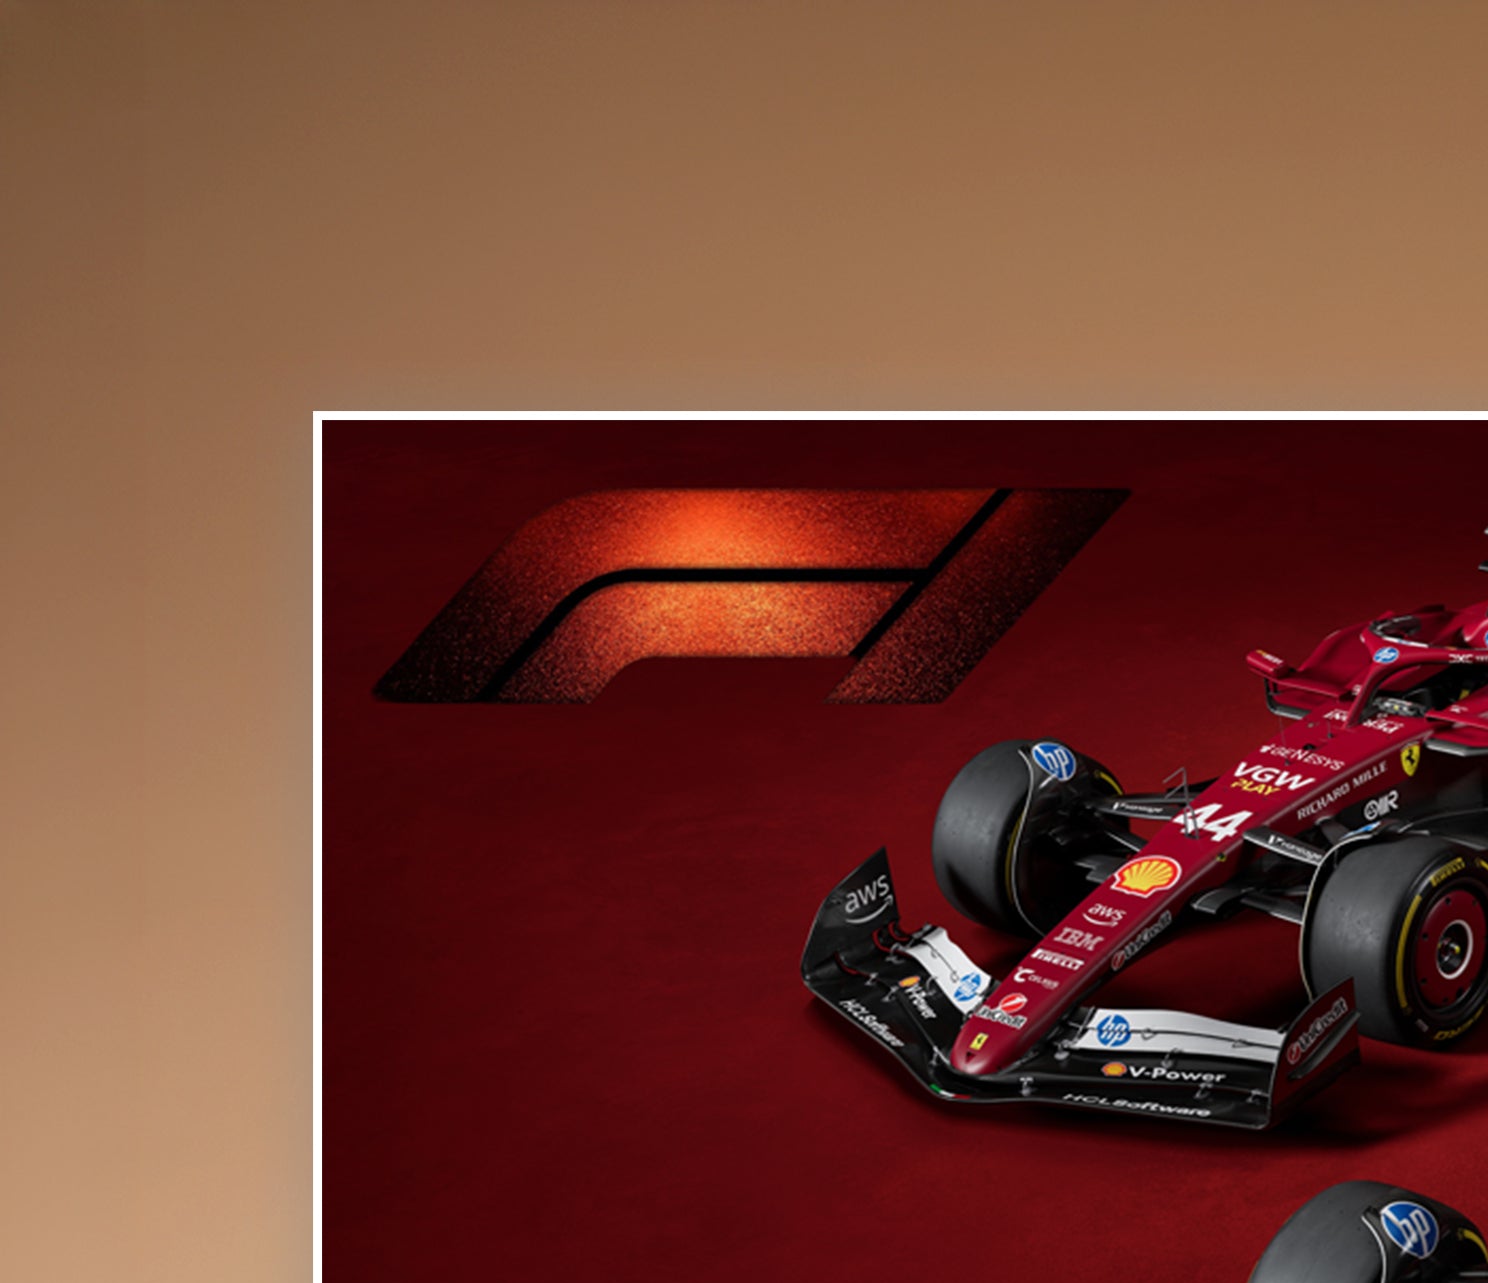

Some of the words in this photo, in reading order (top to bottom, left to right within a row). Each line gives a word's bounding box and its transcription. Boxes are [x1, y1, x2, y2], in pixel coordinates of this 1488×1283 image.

[1032, 743, 1076, 781] hp
[1270, 745, 1345, 771] GENESYS
[1231, 778, 1281, 796] PLAY
[1234, 762, 1315, 791] VGW
[1297, 782, 1349, 820] RICHARD
[1353, 761, 1388, 789] MILLE
[1172, 803, 1252, 842] 44
[845, 875, 891, 914] aws
[1087, 903, 1127, 922] aws
[1054, 927, 1104, 951] IBM
[1031, 948, 1084, 970] PIRELLI
[1097, 1014, 1131, 1047] hp
[1129, 1065, 1226, 1082] V-Power
[1062, 1093, 1211, 1117] HCLSoftware
[1381, 1201, 1439, 1260] hp
